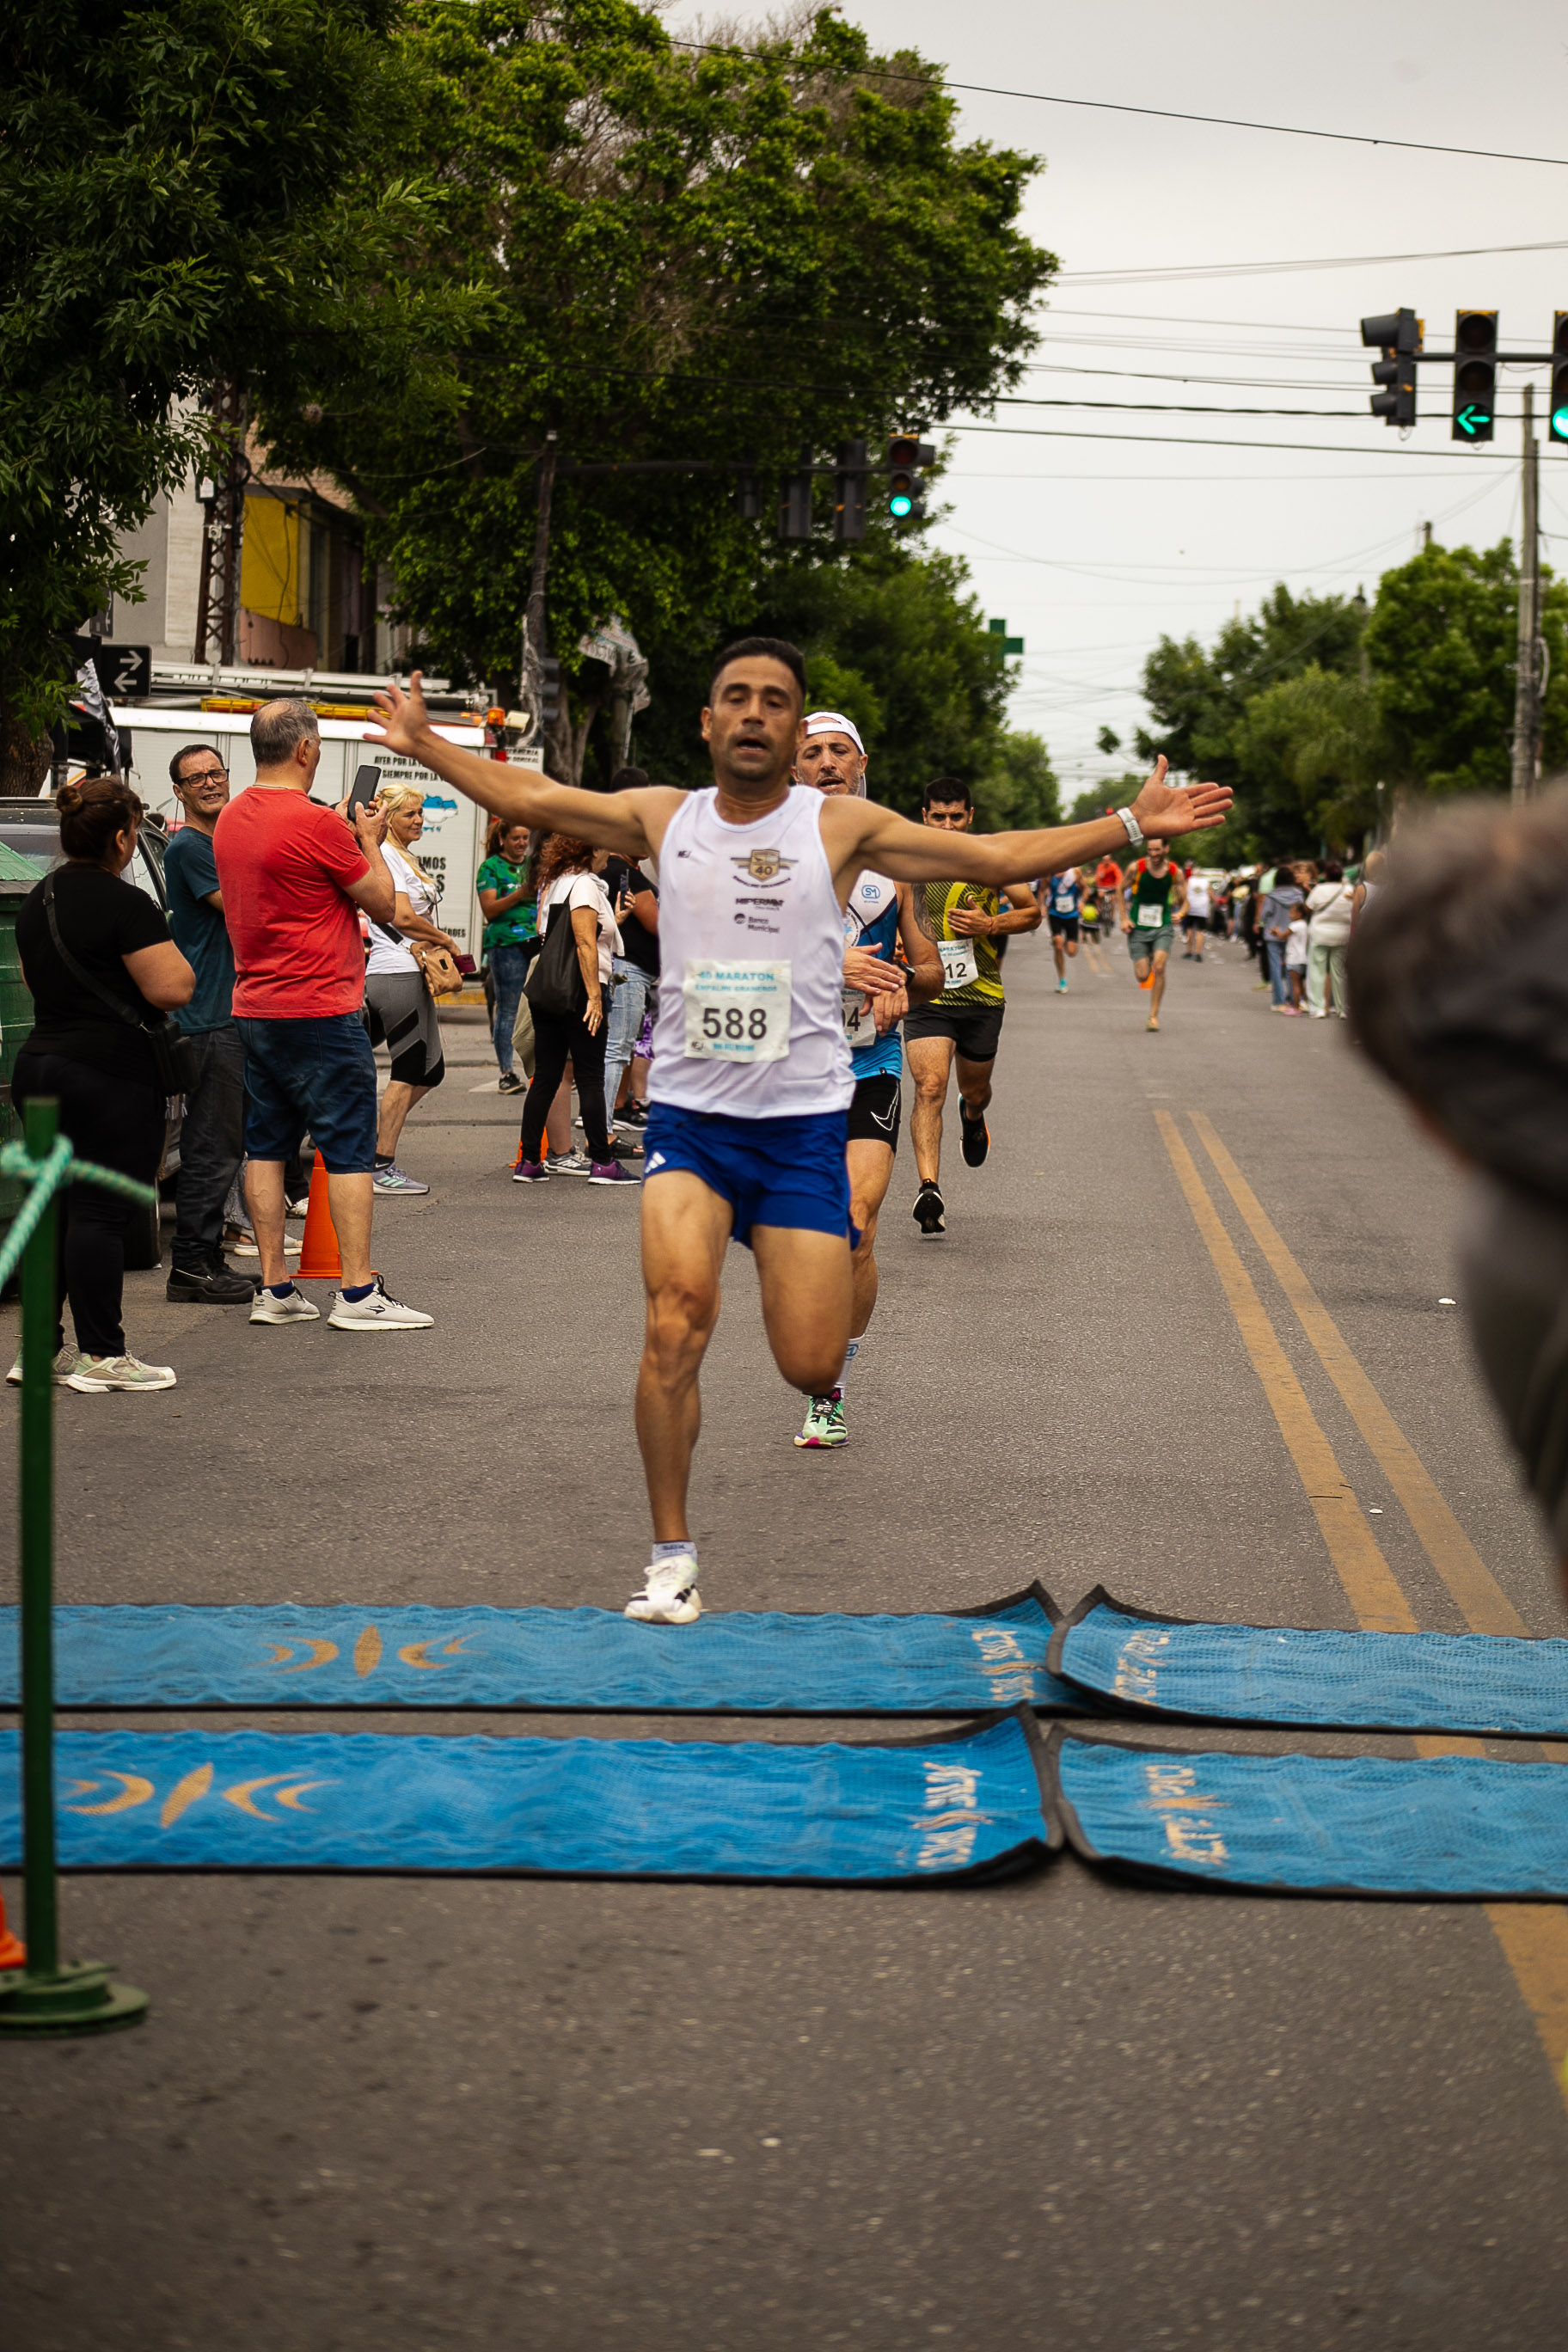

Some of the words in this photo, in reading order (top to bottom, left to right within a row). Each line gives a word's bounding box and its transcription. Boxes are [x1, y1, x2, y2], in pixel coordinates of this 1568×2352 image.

[374, 756, 391, 765] AYER
[393, 756, 407, 766] POR
[408, 758, 418, 767] LA
[382, 769, 413, 780] SIEMPRE
[414, 772, 428, 781] POR
[755, 866, 773, 875] 40
[715, 971, 775, 982] MARATON
[702, 1008, 768, 1040] 588
